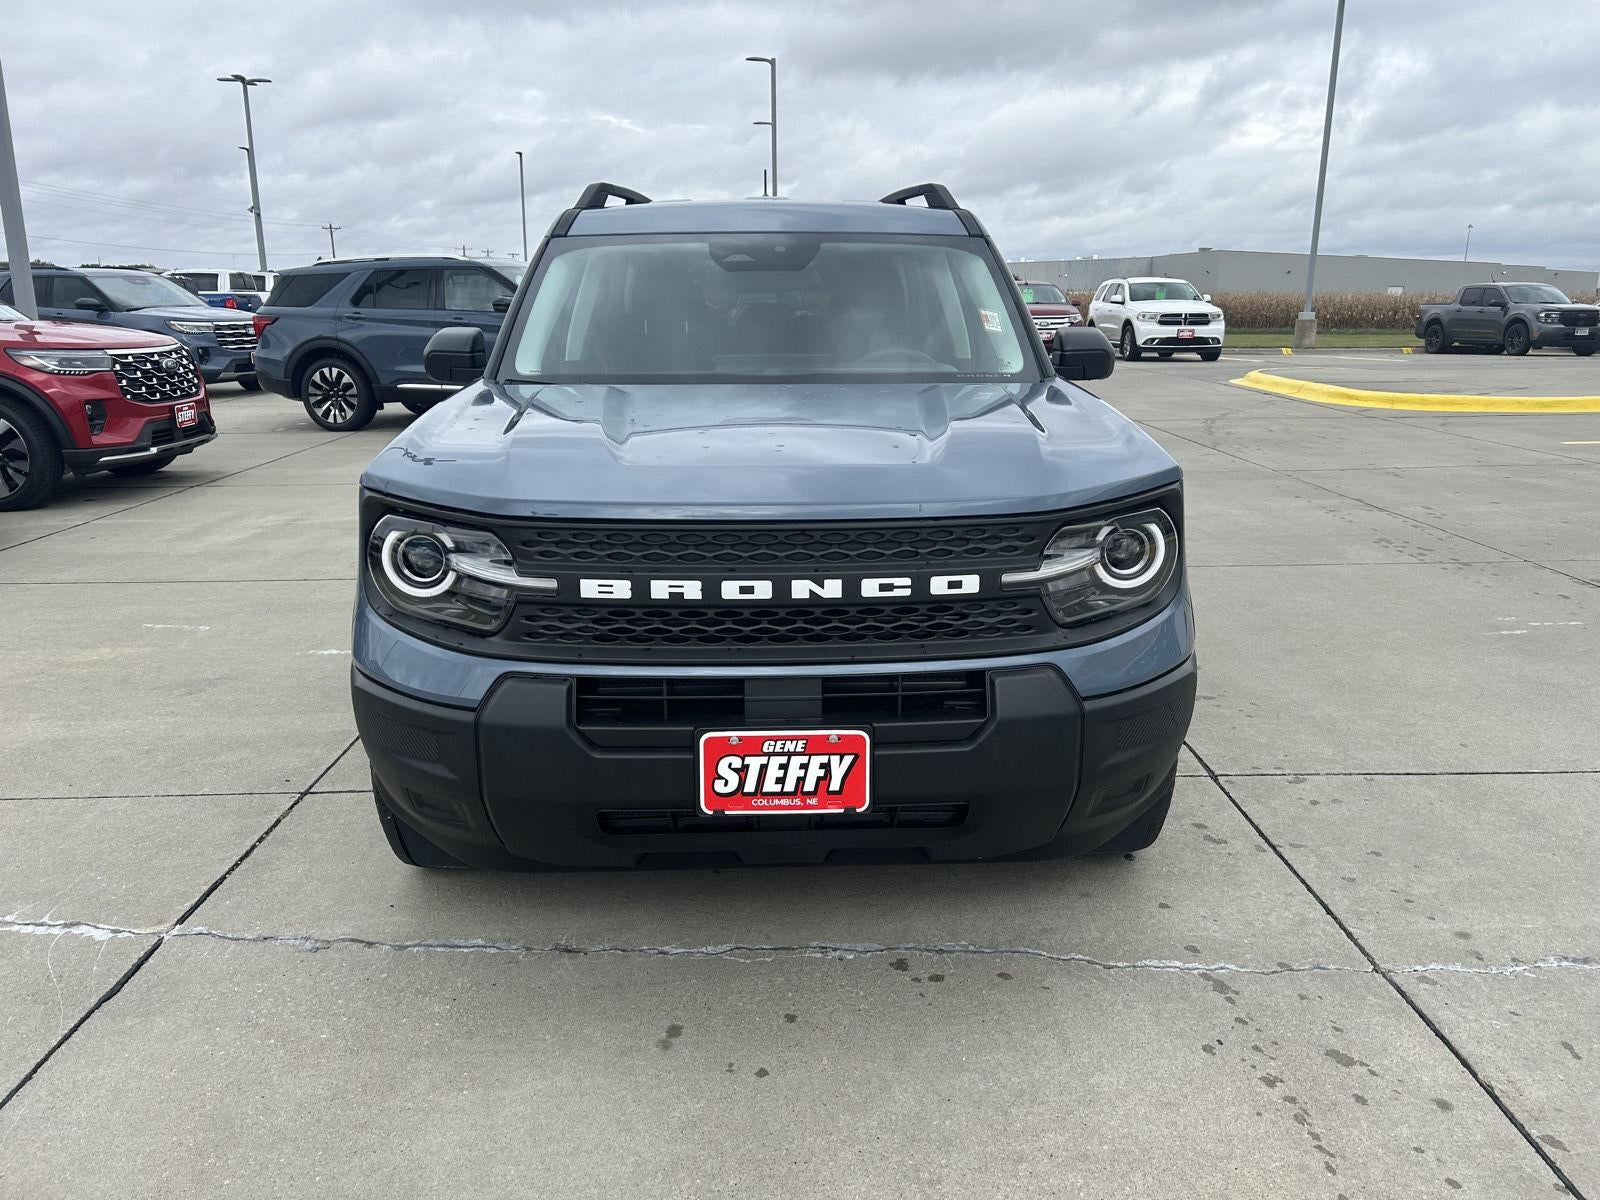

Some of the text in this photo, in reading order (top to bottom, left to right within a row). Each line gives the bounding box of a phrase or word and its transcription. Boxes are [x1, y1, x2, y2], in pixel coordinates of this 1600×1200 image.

[579, 574, 980, 599] BRONCO
[762, 740, 807, 753] GENE
[713, 754, 858, 796] STEFFY
[751, 798, 819, 808] COLUMBUS, NE
